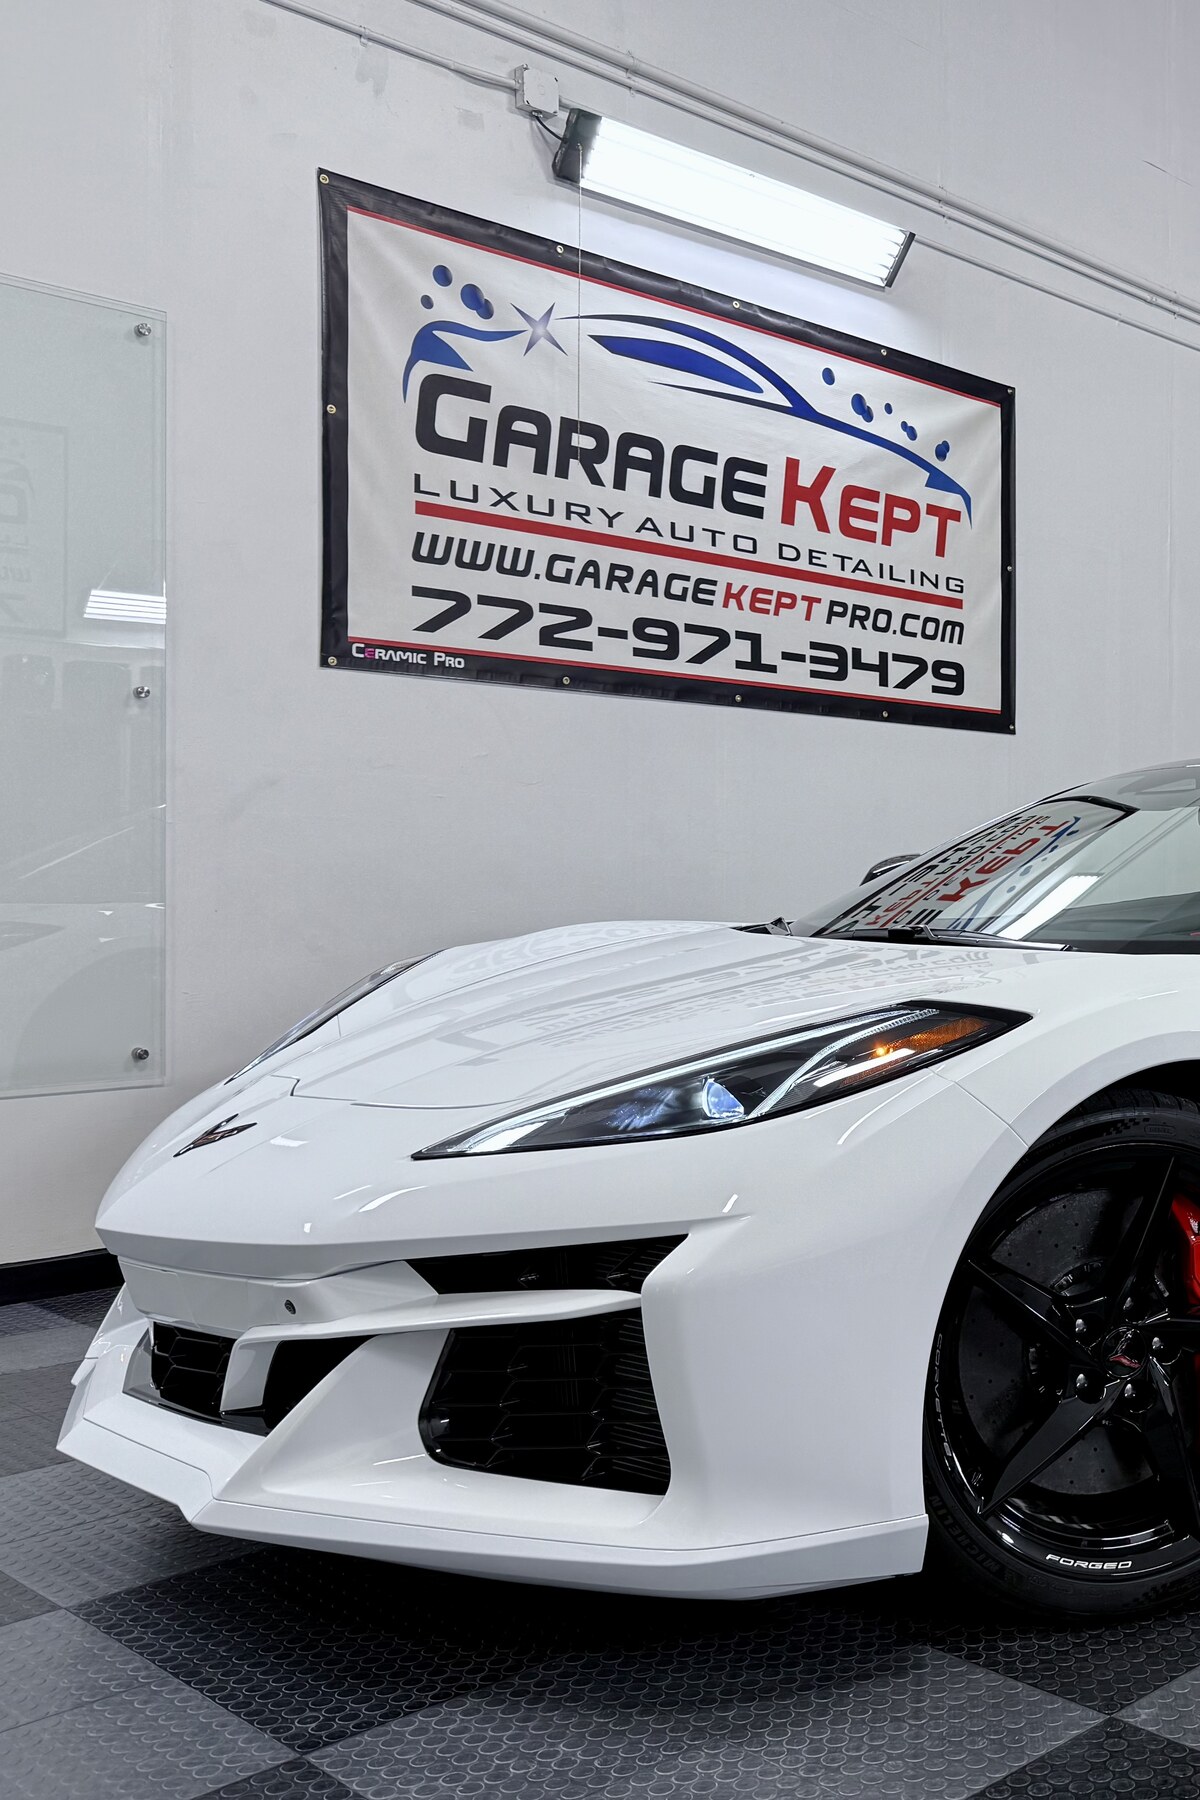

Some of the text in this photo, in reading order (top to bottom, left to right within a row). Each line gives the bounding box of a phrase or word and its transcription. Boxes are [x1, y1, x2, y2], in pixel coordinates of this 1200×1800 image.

[416, 374, 962, 558] GARAGE KEPT
[413, 474, 964, 594] LUXURY AUTO DETAILING
[351, 643, 427, 665] CERAMIC
[411, 586, 965, 695] 772-971-3479
[933, 1332, 953, 1458] CORVETTE
[1045, 1553, 1133, 1571] FORGED
